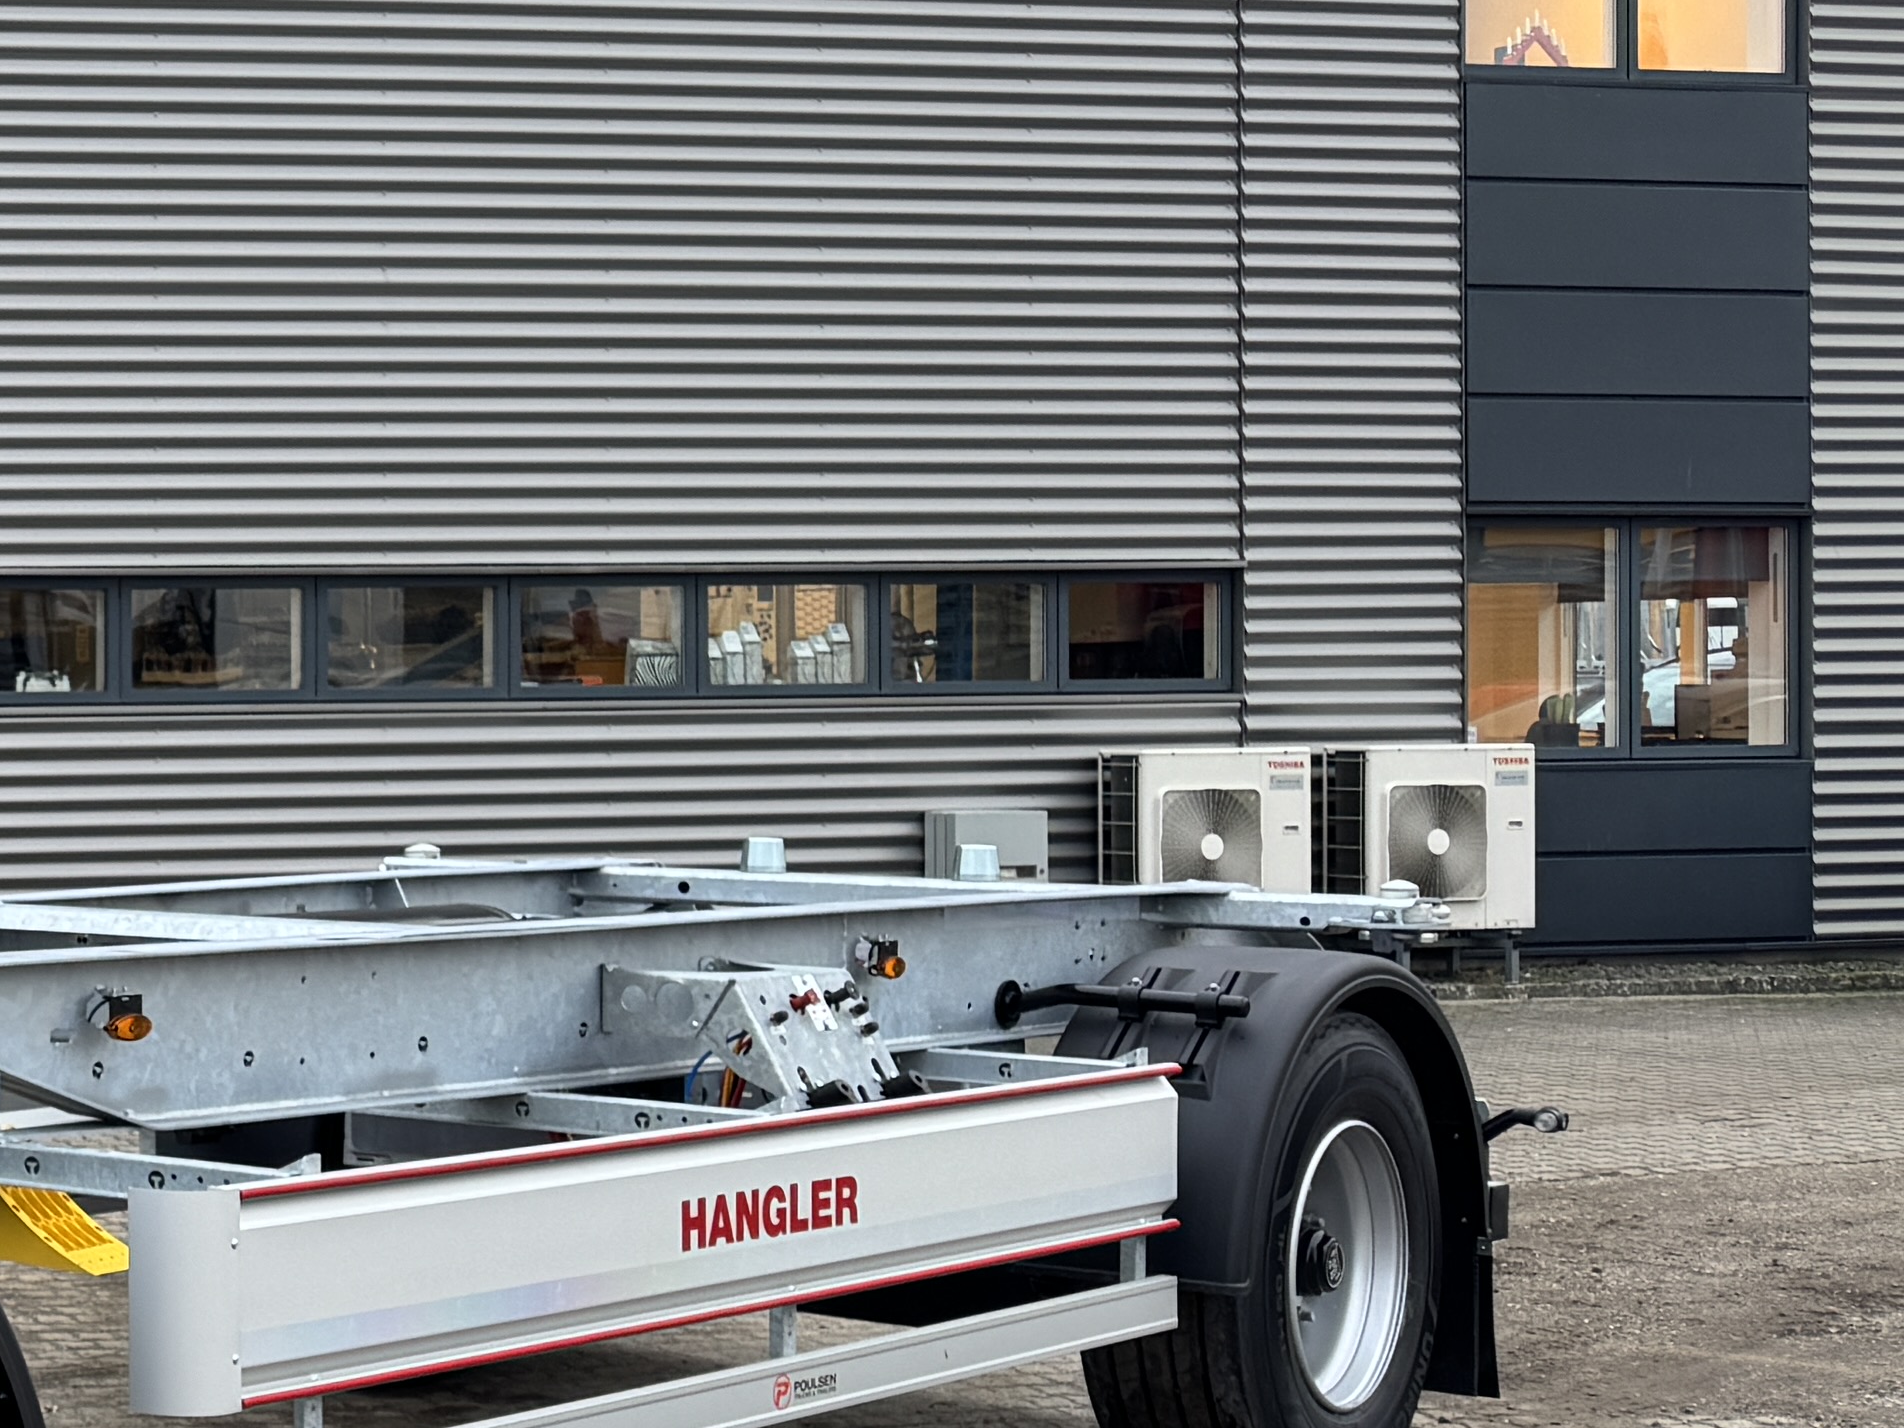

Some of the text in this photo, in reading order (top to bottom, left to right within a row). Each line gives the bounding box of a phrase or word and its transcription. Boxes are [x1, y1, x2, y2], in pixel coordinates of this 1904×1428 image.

[1268, 761, 1305, 769] TOSHIBA
[1493, 757, 1530, 766] TOSHIBA
[681, 1175, 859, 1253] HANGLER
[794, 1372, 837, 1392] POULSEN
